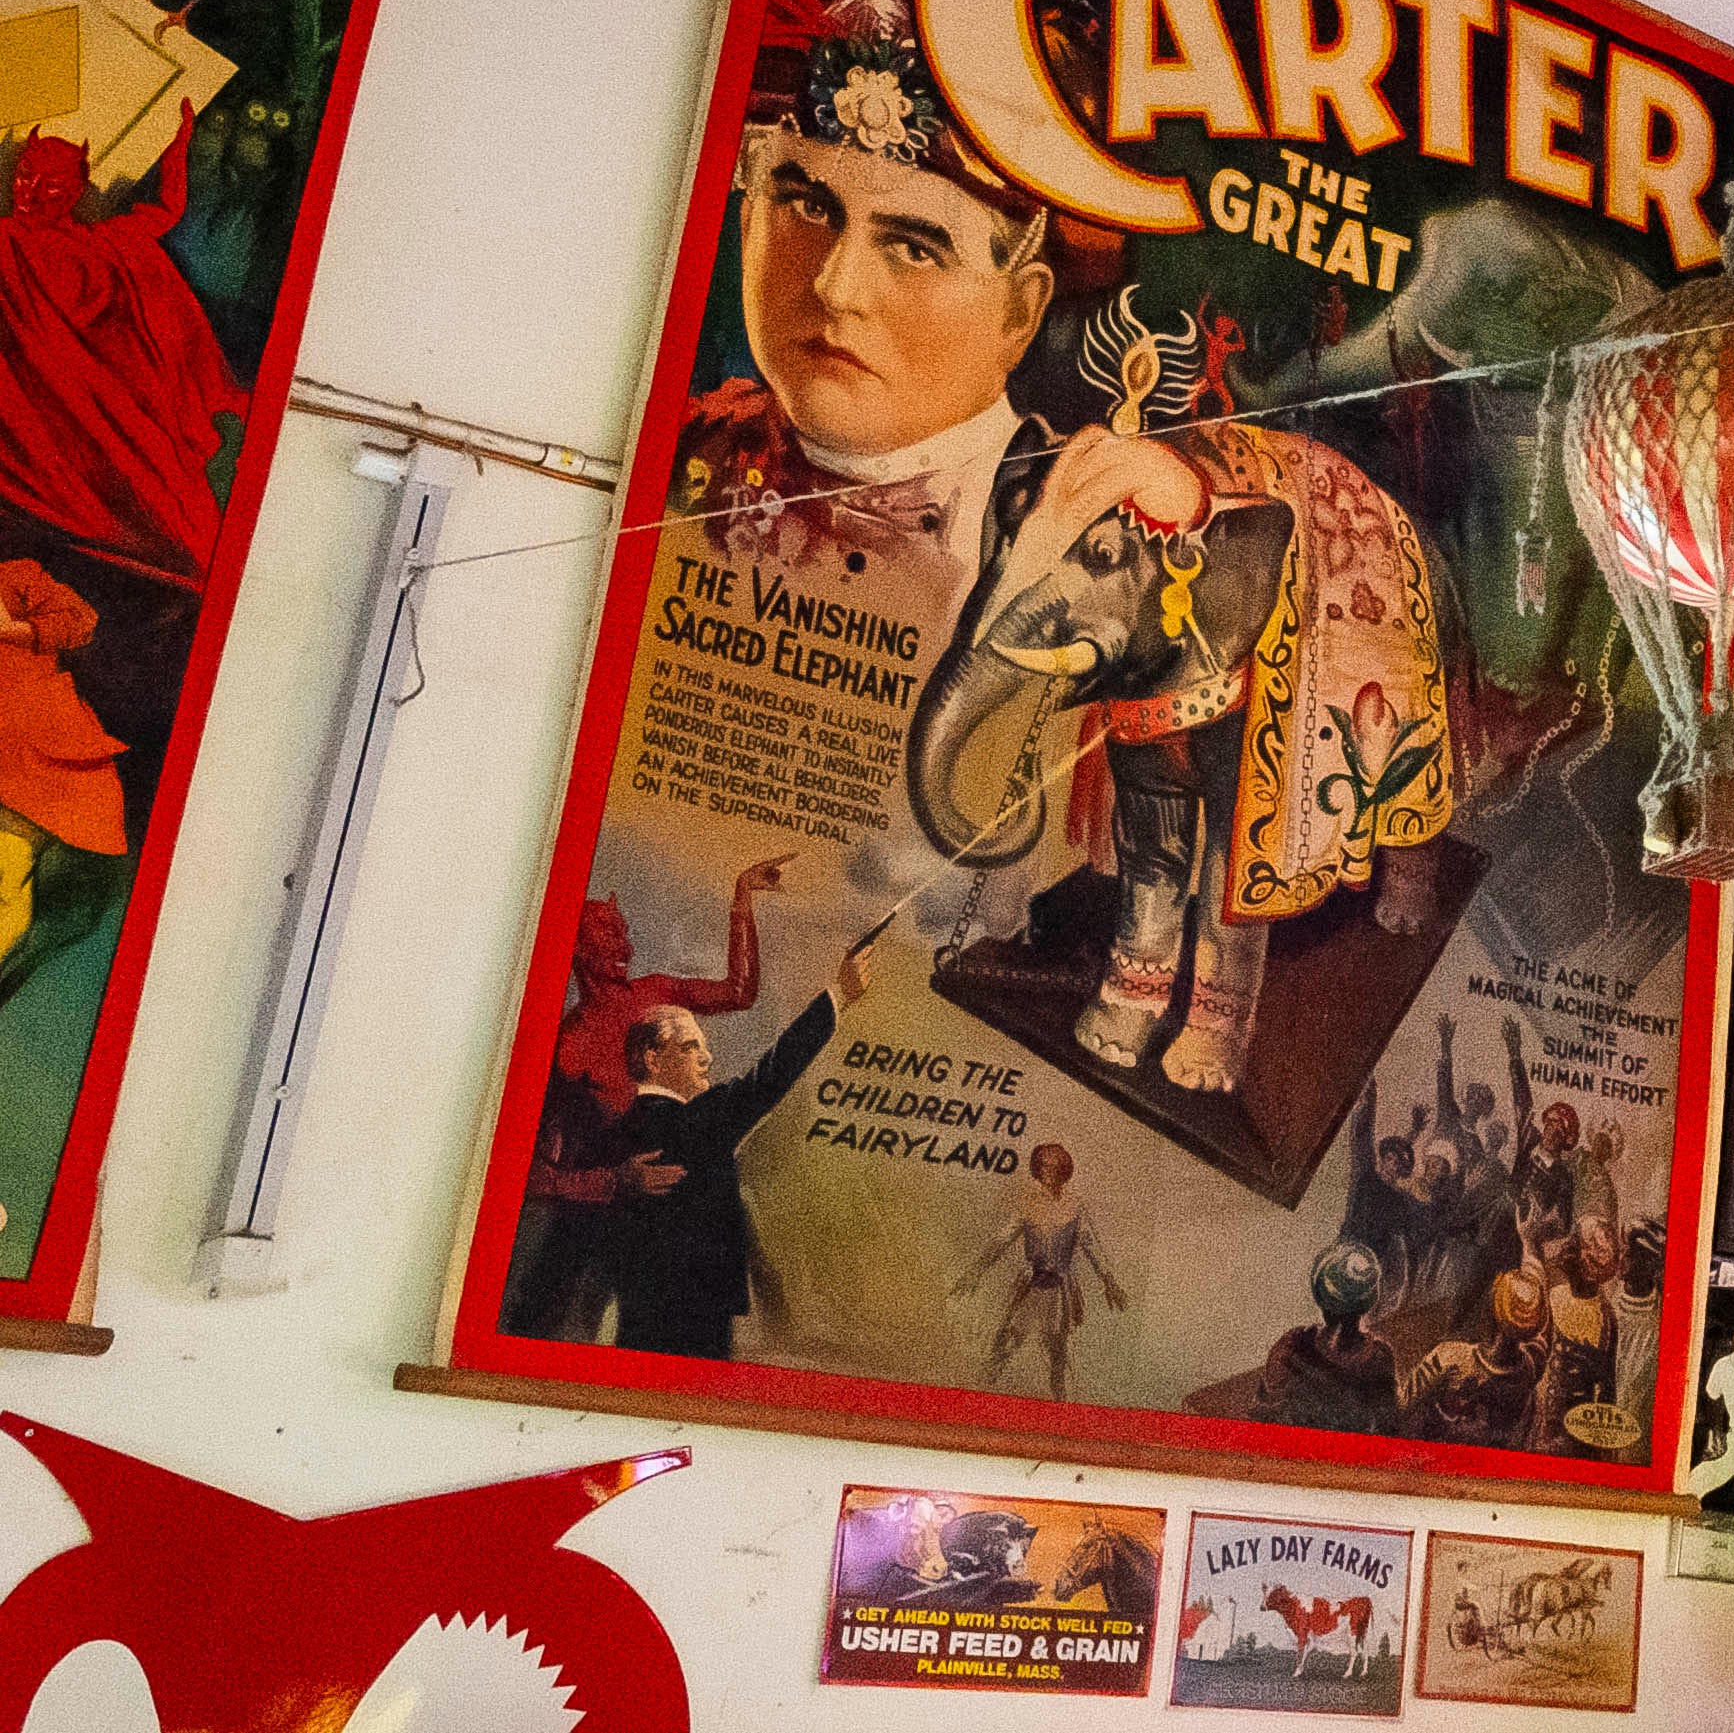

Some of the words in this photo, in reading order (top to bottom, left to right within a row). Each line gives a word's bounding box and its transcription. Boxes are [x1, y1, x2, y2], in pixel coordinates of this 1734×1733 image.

[1279, 146, 1373, 217] THE
[1207, 166, 1412, 293] GREAT
[676, 556, 737, 607] THE
[751, 565, 921, 662] VANISHING
[655, 597, 767, 672] SACRED
[773, 630, 918, 711] ELEPHANT
[650, 682, 715, 716] CARTER
[720, 702, 789, 737] CAUSES
[817, 730, 861, 757] REAL
[867, 744, 902, 768] LIVE
[654, 658, 672, 678] IN
[677, 665, 714, 690] THIS
[717, 678, 817, 720] MARVELOUS
[822, 707, 902, 745] ILLUSION
[642, 725, 699, 758] VANISH
[763, 763, 791, 784] ALL
[730, 729, 799, 763] ELEPHANT
[631, 771, 661, 796] ON
[667, 781, 702, 807] THE
[637, 750, 665, 771] AN
[669, 760, 793, 806] ACHIEVEMENT
[794, 791, 890, 831] BORDERING
[1468, 976, 1544, 1010] MAGICAL
[1554, 997, 1680, 1038] ACHIEVEMENT
[1512, 955, 1550, 983] THE
[1555, 967, 1607, 996] ACME
[1614, 979, 1638, 1001] OF
[843, 1039, 953, 1083] BRING
[961, 1059, 1024, 1097] THE
[1542, 1036, 1615, 1069] SUMMIT
[1621, 1054, 1650, 1077] OF
[817, 1079, 984, 1129] CHILDREN
[993, 1106, 1027, 1138] TO
[1529, 1064, 1595, 1093] HUMAN
[1601, 1081, 1670, 1108] EFFORT
[805, 1118, 1020, 1175] FAIRYLAND
[1206, 1538, 1261, 1575] LAZY
[1271, 1535, 1313, 1563] DAY
[1322, 1539, 1393, 1589] FARMS
[841, 1625, 938, 1655] USHER
[949, 1631, 1023, 1658] FEED
[1030, 1636, 1049, 1660] &
[1055, 1638, 1140, 1663] GRAIN
[856, 1607, 888, 1622] GET
[894, 1610, 949, 1625] AHEAD
[954, 1612, 995, 1627] WITH
[1000, 1614, 1051, 1631] STOCK
[1057, 1618, 1098, 1633] WELL
[1103, 1620, 1132, 1634] FED
